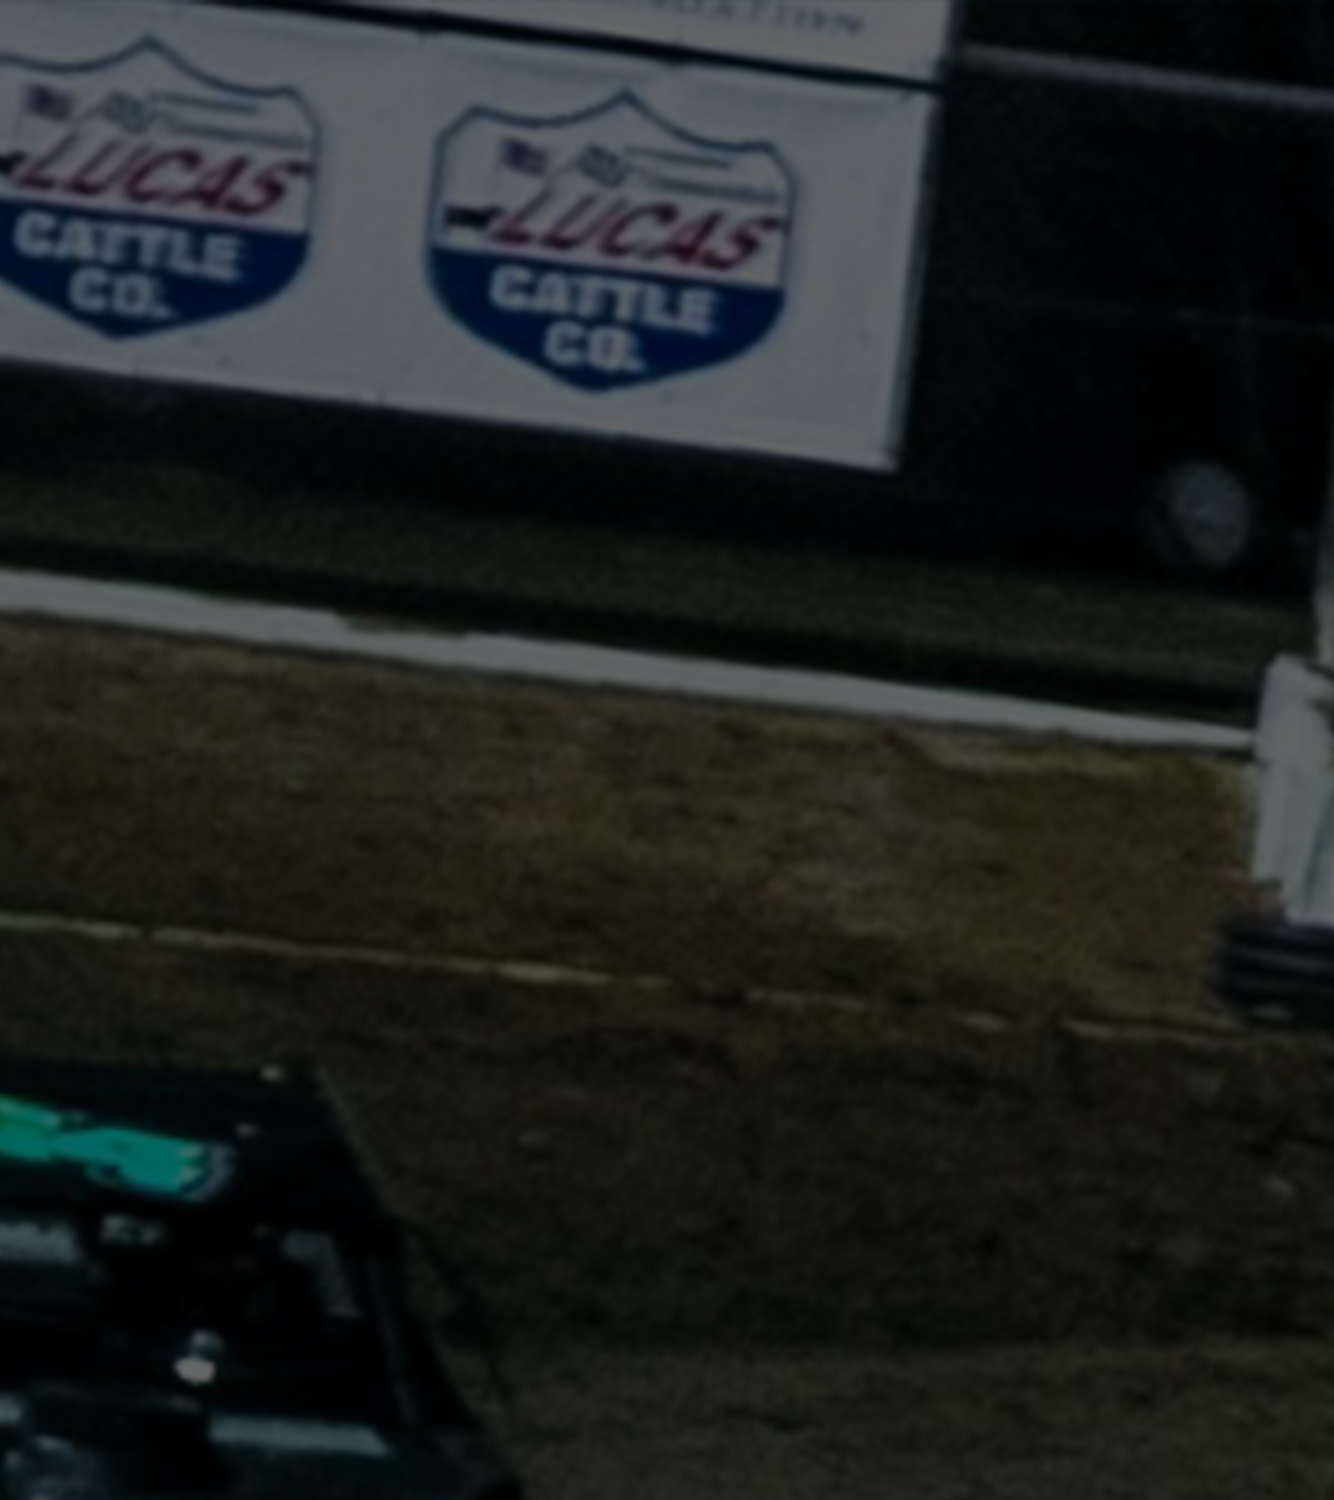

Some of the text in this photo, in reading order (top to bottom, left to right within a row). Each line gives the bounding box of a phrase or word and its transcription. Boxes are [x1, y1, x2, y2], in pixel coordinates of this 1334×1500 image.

[12, 130, 312, 217] LUCAS
[11, 208, 249, 285] CATTLE
[489, 190, 787, 270] LUCAS
[68, 272, 183, 322] CO.
[487, 263, 724, 337] CATTLE
[540, 319, 649, 376] CO.
